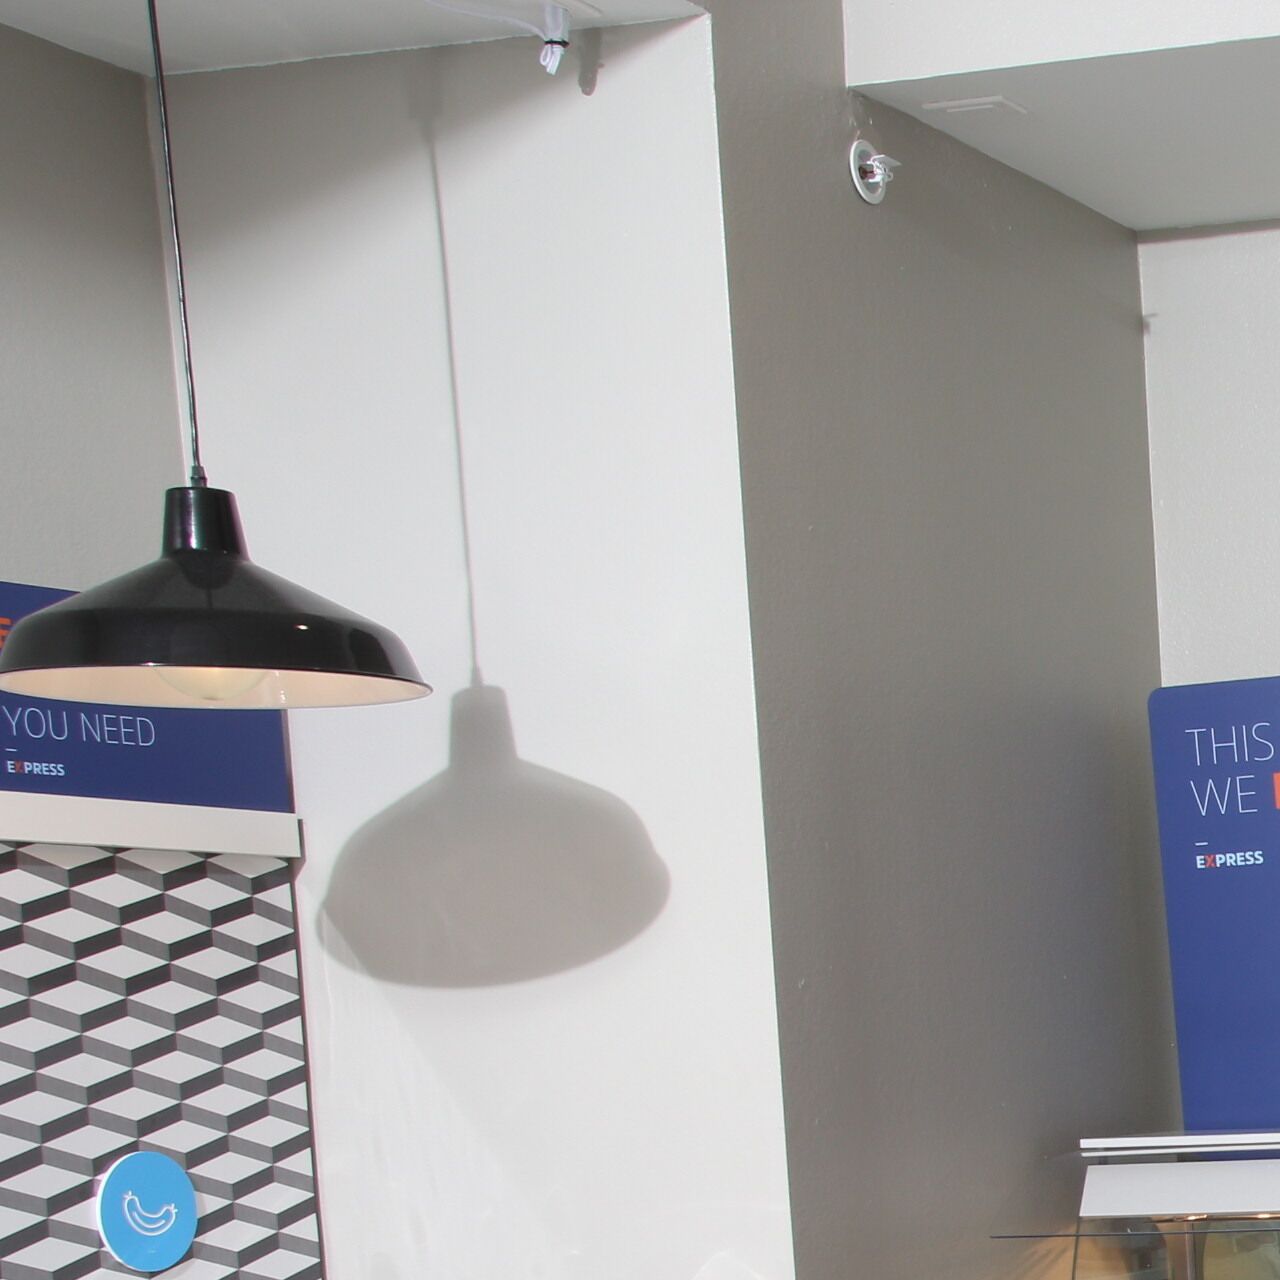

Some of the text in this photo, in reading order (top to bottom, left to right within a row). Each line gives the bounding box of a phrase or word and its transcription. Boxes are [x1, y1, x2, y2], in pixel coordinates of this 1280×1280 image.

[2, 705, 156, 747] YOU NEED
[1185, 721, 1275, 767] THIS
[6, 760, 66, 777] EXPRESS
[1190, 774, 1259, 817] WE
[1196, 850, 1264, 869] EXPRESS
